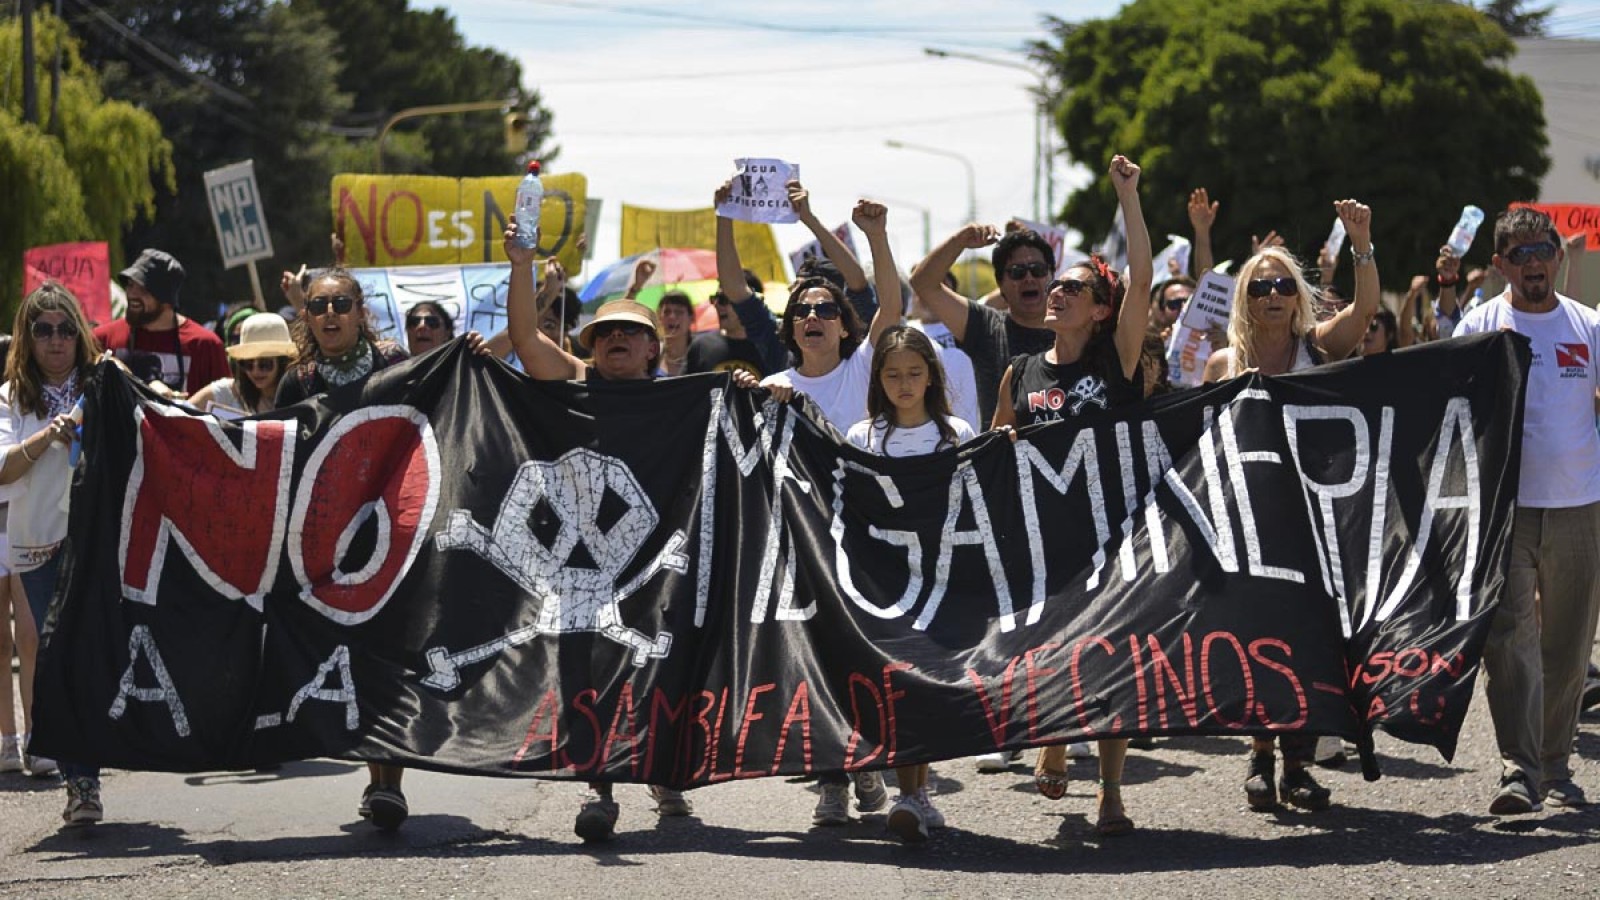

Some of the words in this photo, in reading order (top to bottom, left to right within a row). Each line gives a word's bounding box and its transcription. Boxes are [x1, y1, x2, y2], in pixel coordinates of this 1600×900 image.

[223, 223, 263, 257] NO
[336, 184, 424, 265] NO
[427, 210, 475, 249] ES
[37, 256, 94, 279] AGUA
[1027, 387, 1066, 413] NO
[118, 401, 442, 627] NO
[108, 623, 191, 738] A
[511, 680, 813, 782] ASAMBLEA
[843, 661, 915, 773] DE
[967, 630, 1307, 749] VECINOS
